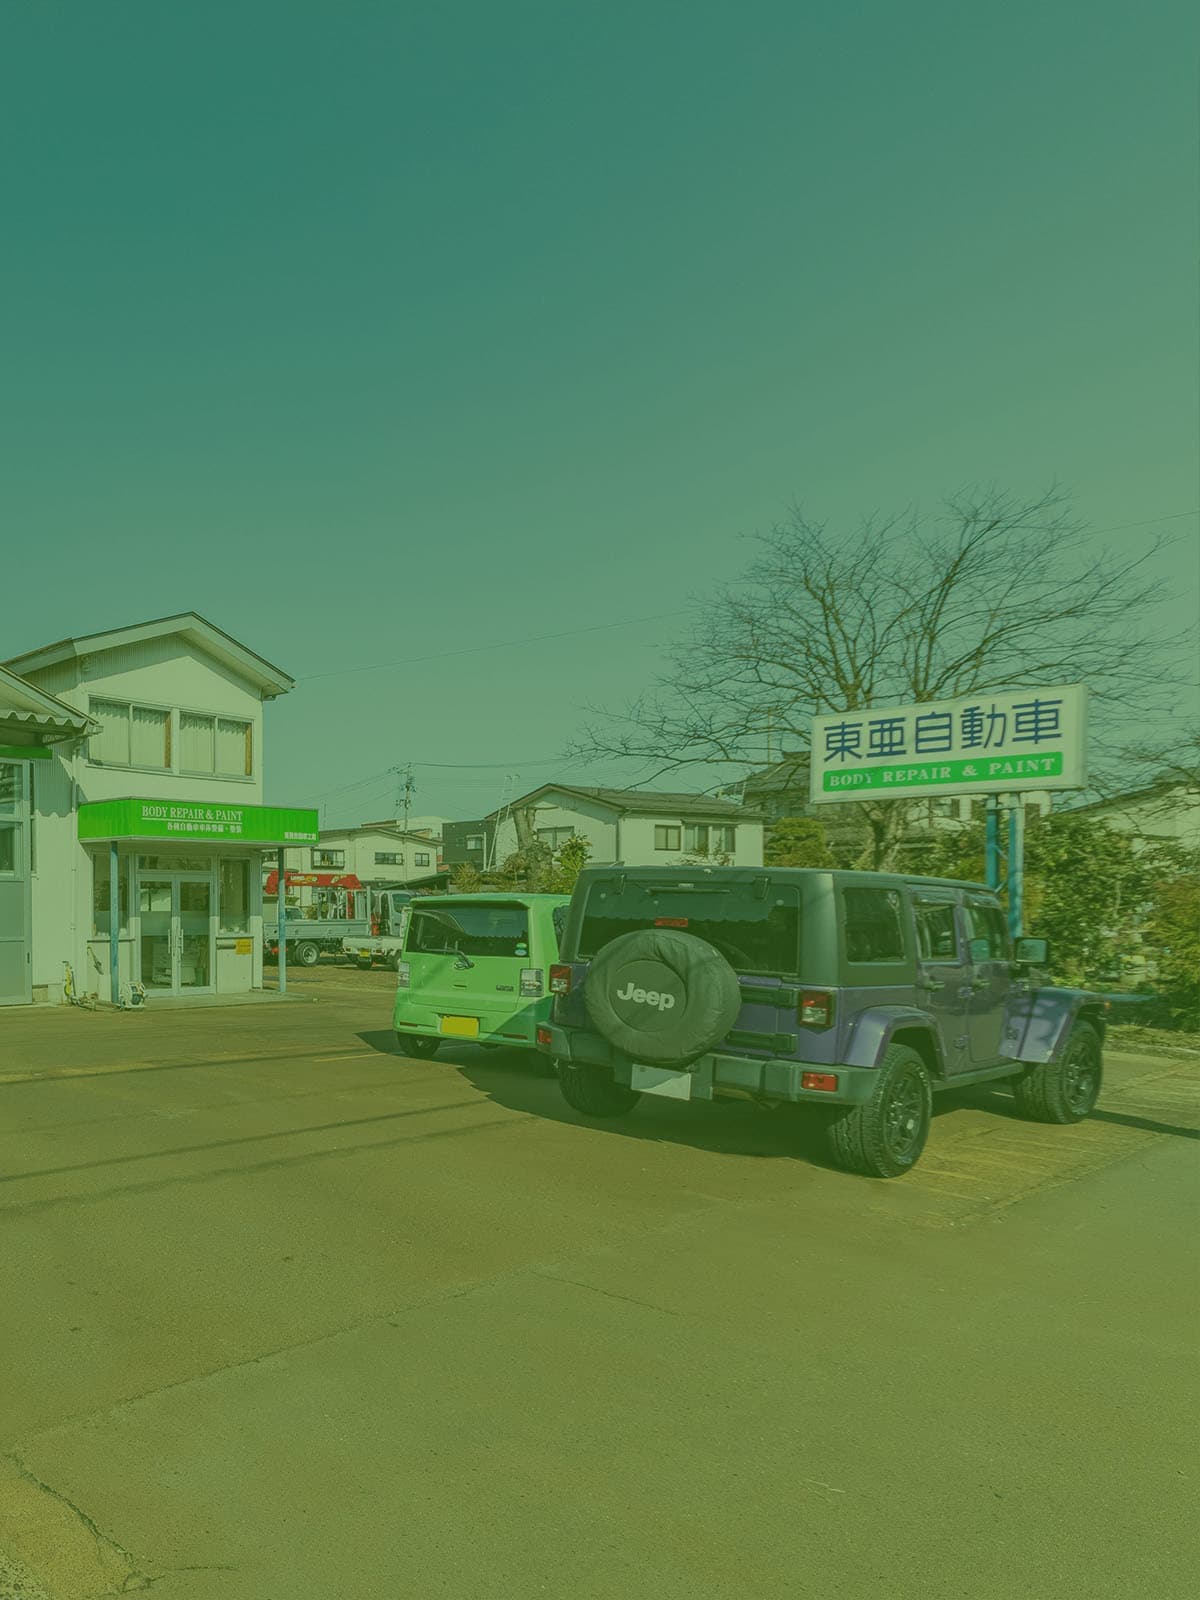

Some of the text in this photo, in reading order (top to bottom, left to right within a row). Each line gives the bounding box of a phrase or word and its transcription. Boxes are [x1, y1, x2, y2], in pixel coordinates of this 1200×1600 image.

[823, 699, 1063, 763] 東亜自動車
[829, 758, 1056, 787] BODY REPAIR & PAINT
[141, 805, 243, 822] BODY REPAIR & PAINT
[616, 982, 676, 1011] Jeep
